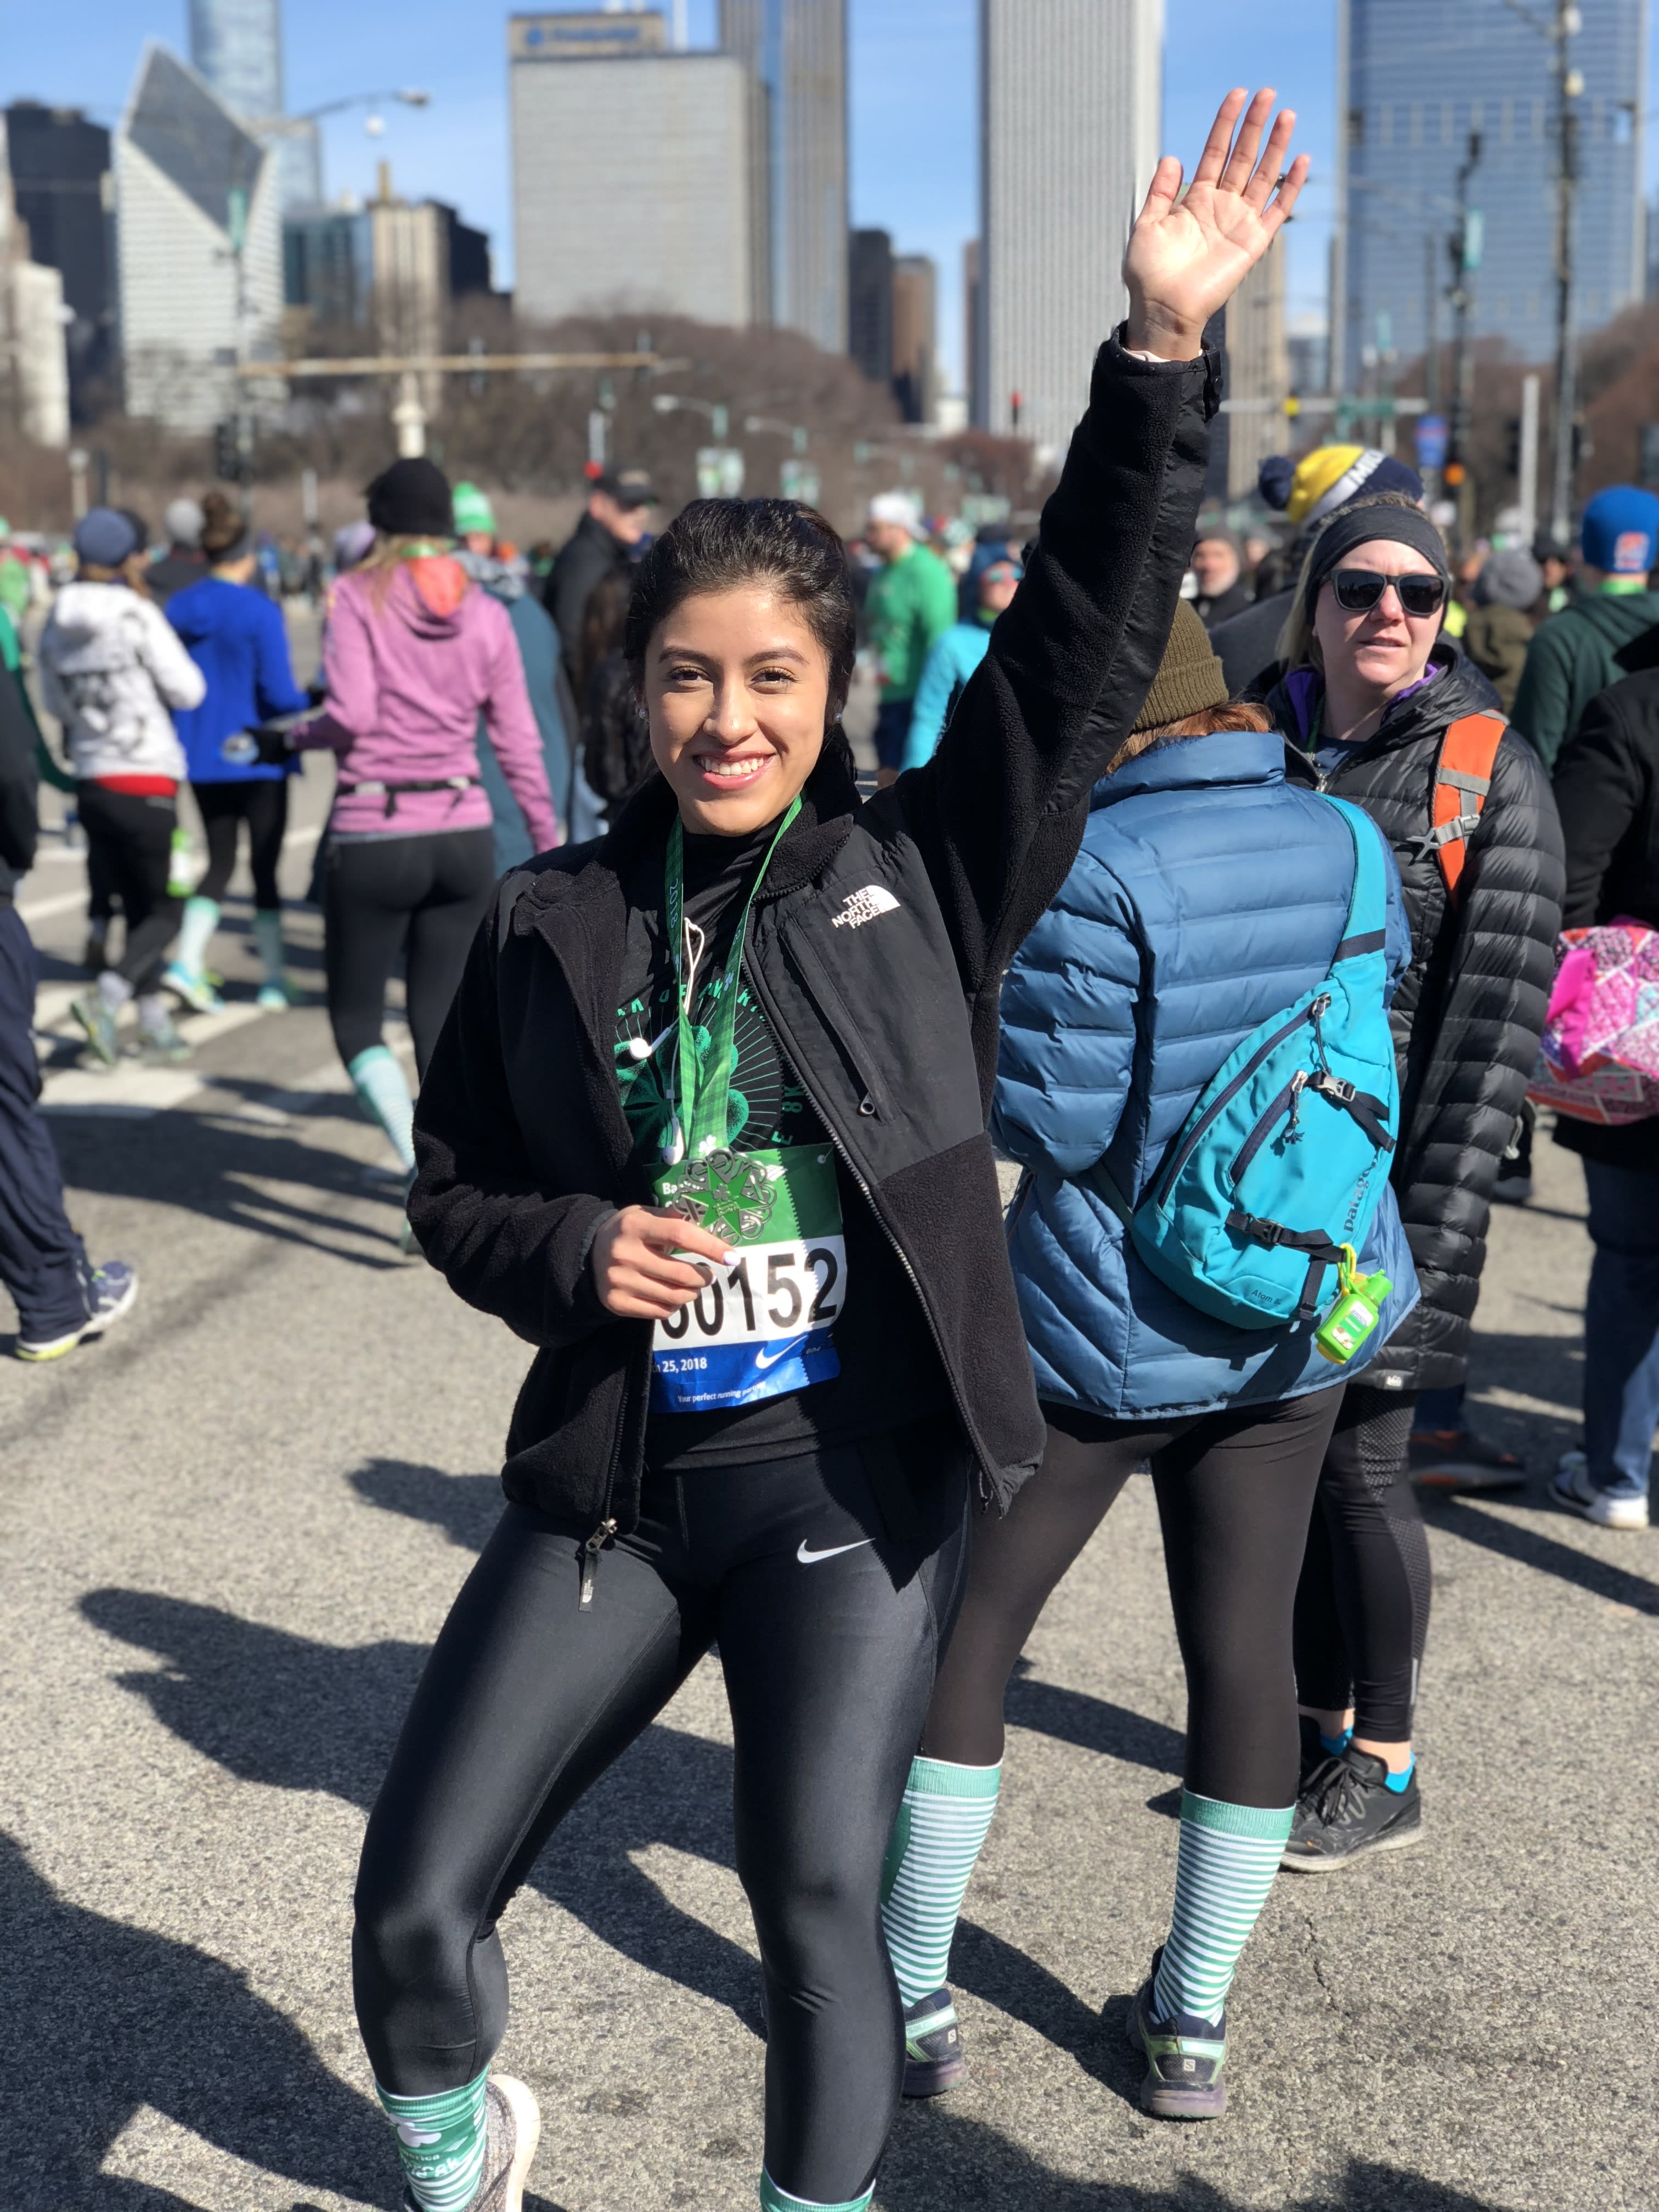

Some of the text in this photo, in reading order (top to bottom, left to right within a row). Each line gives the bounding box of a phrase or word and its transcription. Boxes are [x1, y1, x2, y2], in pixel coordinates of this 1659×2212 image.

[669, 878, 679, 928] 2018
[842, 888, 871, 907] THE
[831, 897, 877, 928] NORTH
[848, 904, 881, 929] FACE
[1251, 1289, 1273, 1302] Atom
[662, 1360, 679, 1373] 25,
[680, 1357, 707, 1371] 2018
[692, 1392, 716, 1403] perfect
[718, 1390, 741, 1398] running
